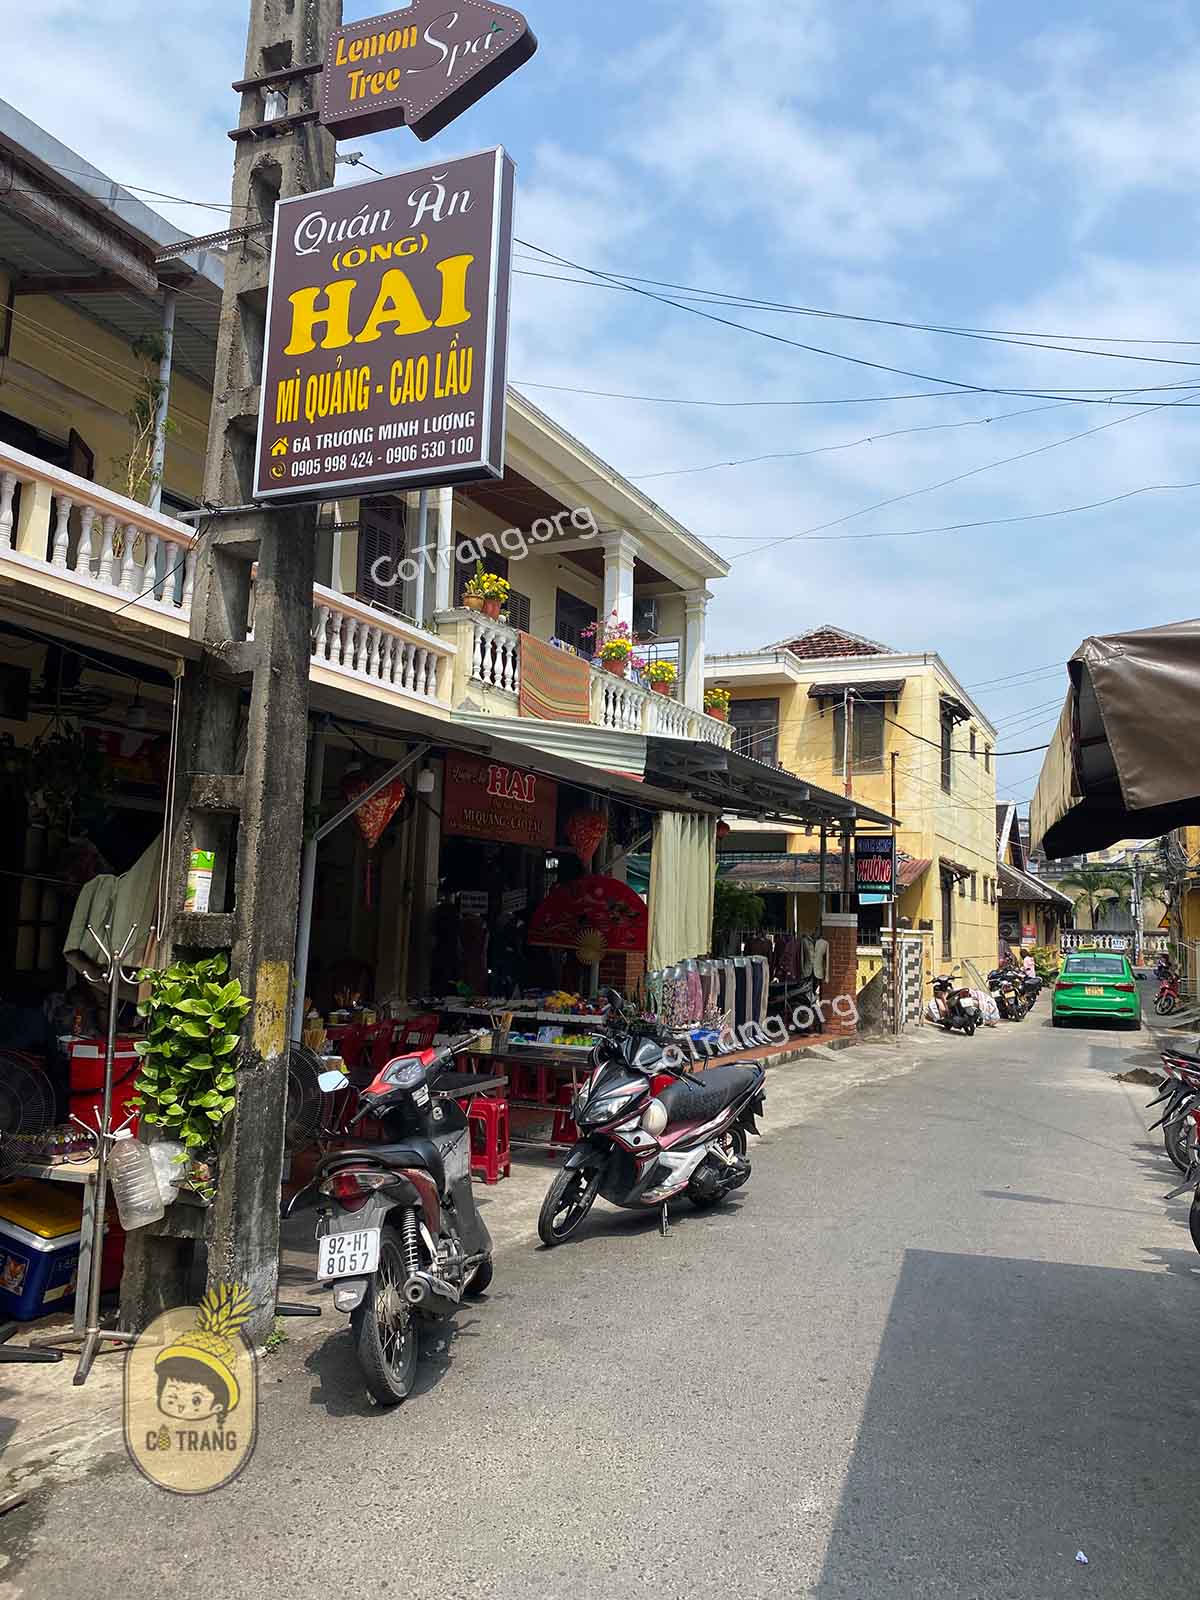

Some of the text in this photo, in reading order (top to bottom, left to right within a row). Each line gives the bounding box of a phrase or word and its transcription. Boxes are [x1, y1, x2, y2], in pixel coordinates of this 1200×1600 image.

[336, 24, 417, 66] Lemon
[407, 10, 494, 77] Spa
[347, 66, 401, 101] Tree
[294, 171, 476, 256] Quán Ăn
[331, 233, 429, 272] (ÔNG)
[283, 254, 474, 356] HAI
[275, 368, 300, 424] MÌ
[305, 355, 371, 424] QUẢNG
[390, 355, 429, 406] CAO
[434, 332, 473, 398] LẦU
[292, 411, 475, 453] 6A TRƯƠNG MINH LƯỢNG
[291, 459, 321, 477] 0905
[324, 455, 347, 473] 998
[350, 451, 374, 469] 424
[386, 444, 417, 464] 0906
[421, 440, 446, 459] 530
[450, 436, 474, 455] 100
[486, 764, 537, 803] HAI
[327, 1252, 369, 1275] 8057
